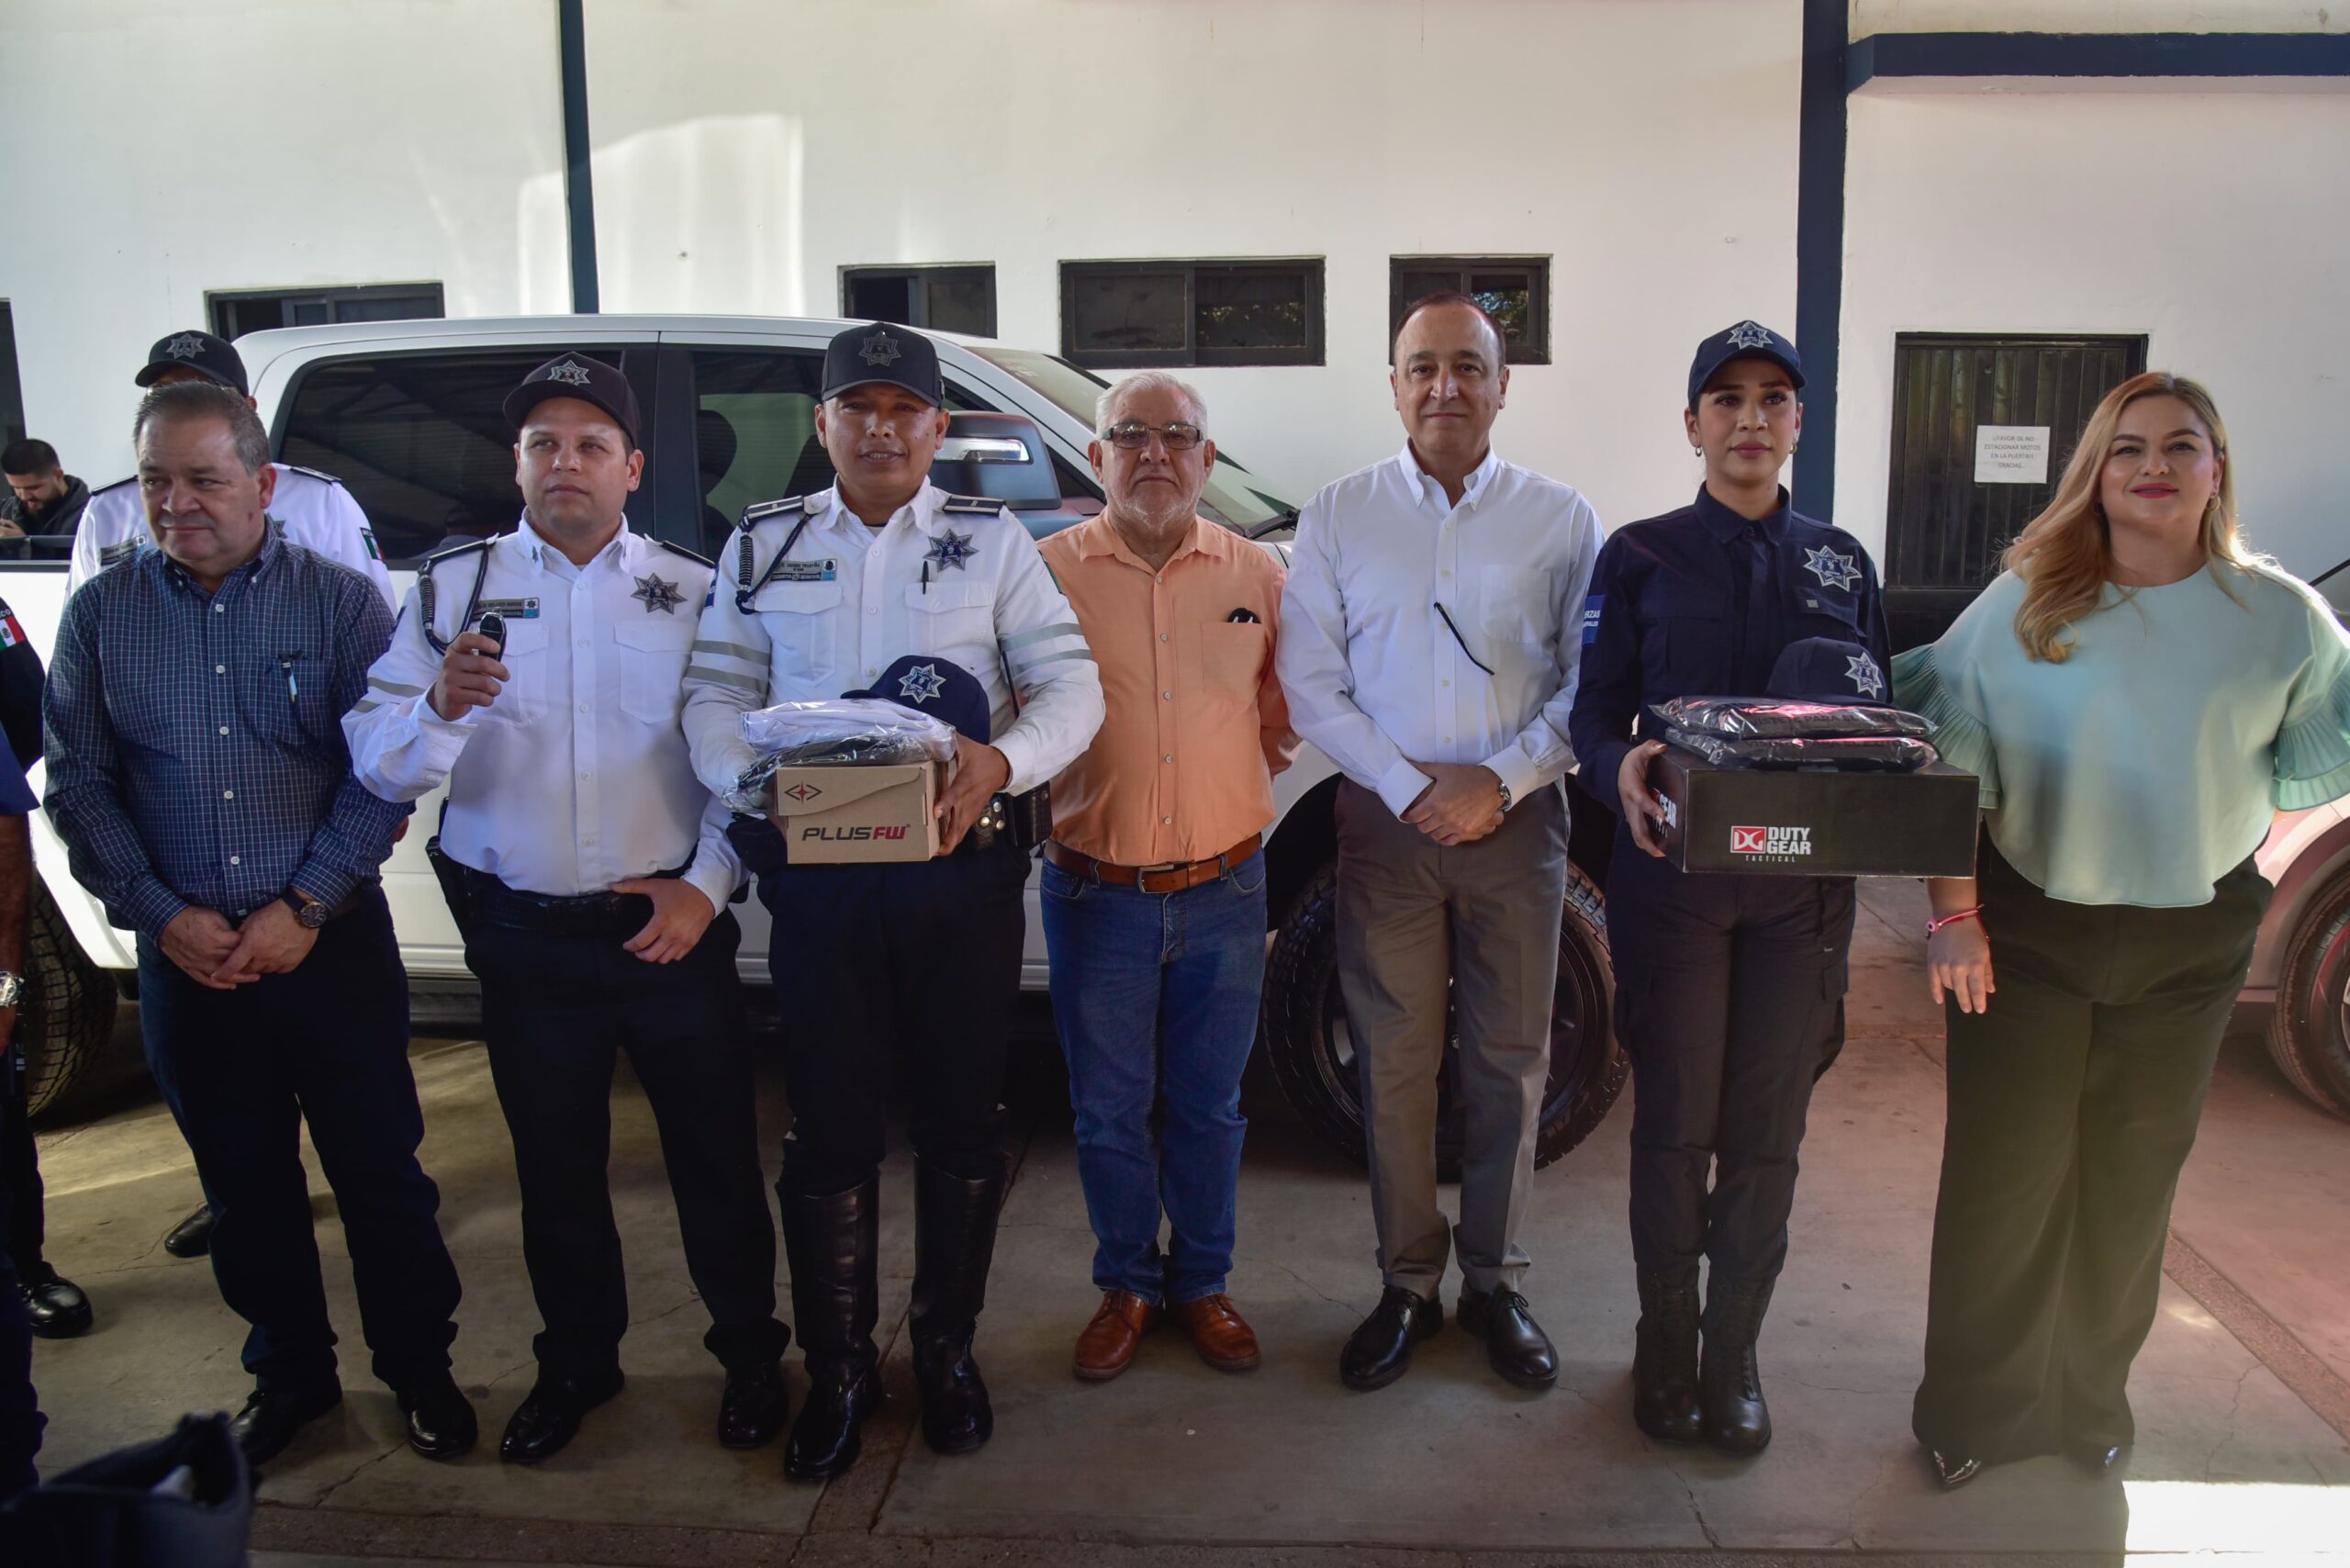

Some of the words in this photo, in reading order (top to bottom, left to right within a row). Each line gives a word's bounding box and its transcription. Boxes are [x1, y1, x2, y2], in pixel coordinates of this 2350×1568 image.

[1767, 826, 1811, 841] DUTY
[1766, 840, 1812, 856] GEAR
[1745, 855, 1796, 863] TACTICAL
